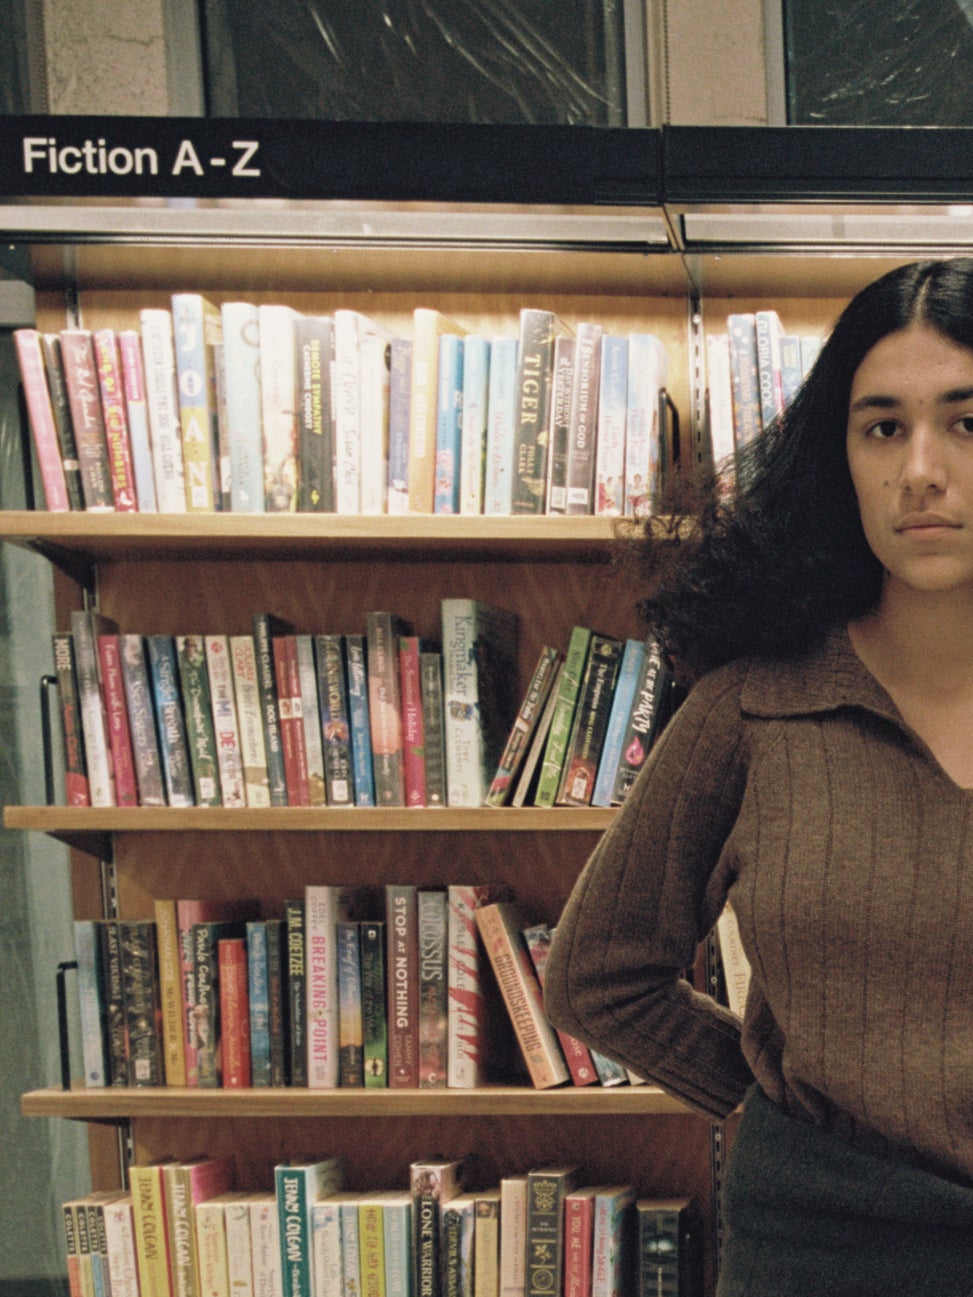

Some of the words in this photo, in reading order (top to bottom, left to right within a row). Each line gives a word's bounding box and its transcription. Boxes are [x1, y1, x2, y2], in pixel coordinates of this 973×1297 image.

[23, 137, 158, 175] Fiction
[311, 340, 321, 380] REMOTE
[759, 320, 771, 369] GLORIA
[303, 345, 312, 390] CATHERINE
[579, 346, 593, 411] SENSORIUM
[521, 354, 541, 424] TIGER
[555, 368, 565, 428] YESTERDAY
[761, 371, 772, 408] COOK
[312, 384, 322, 434] SYMPATHY
[577, 425, 587, 448] GOD
[110, 433, 128, 489] NUMBERS
[518, 444, 527, 474] CLARK
[526, 445, 535, 474] POLLY
[55, 639, 71, 671] MORE
[449, 615, 472, 697] Kingmaker
[596, 664, 607, 677] The
[406, 669, 417, 706] Summer
[133, 708, 150, 747] Sisters
[164, 701, 179, 744] Breath
[266, 704, 276, 722] DOG
[406, 707, 419, 743] Holiday
[632, 691, 655, 734] PARTY
[269, 724, 279, 752] ISLAND
[288, 907, 301, 931] J.M.
[395, 897, 406, 936] STOP
[289, 932, 303, 976] COETZEE
[396, 941, 406, 953] AT
[421, 902, 443, 981] COLOSSUS
[312, 936, 326, 1009] BREAKING
[395, 957, 408, 1028] NOTHING
[493, 954, 541, 1052] GROUNDSKEEPING
[312, 1020, 327, 1062] POINT
[139, 1177, 155, 1211] JENNY
[172, 1183, 185, 1217] JENNY
[283, 1177, 299, 1213] JENNY
[65, 1214, 76, 1253] COLETTE
[78, 1213, 88, 1252] COLETTE
[88, 1211, 97, 1249] COLETTE
[142, 1215, 158, 1259] COLGAN
[286, 1216, 302, 1262] COLGAN
[421, 1201, 434, 1238] LONE
[175, 1221, 190, 1266] COLGAN
[421, 1240, 433, 1296] WARRIOR
